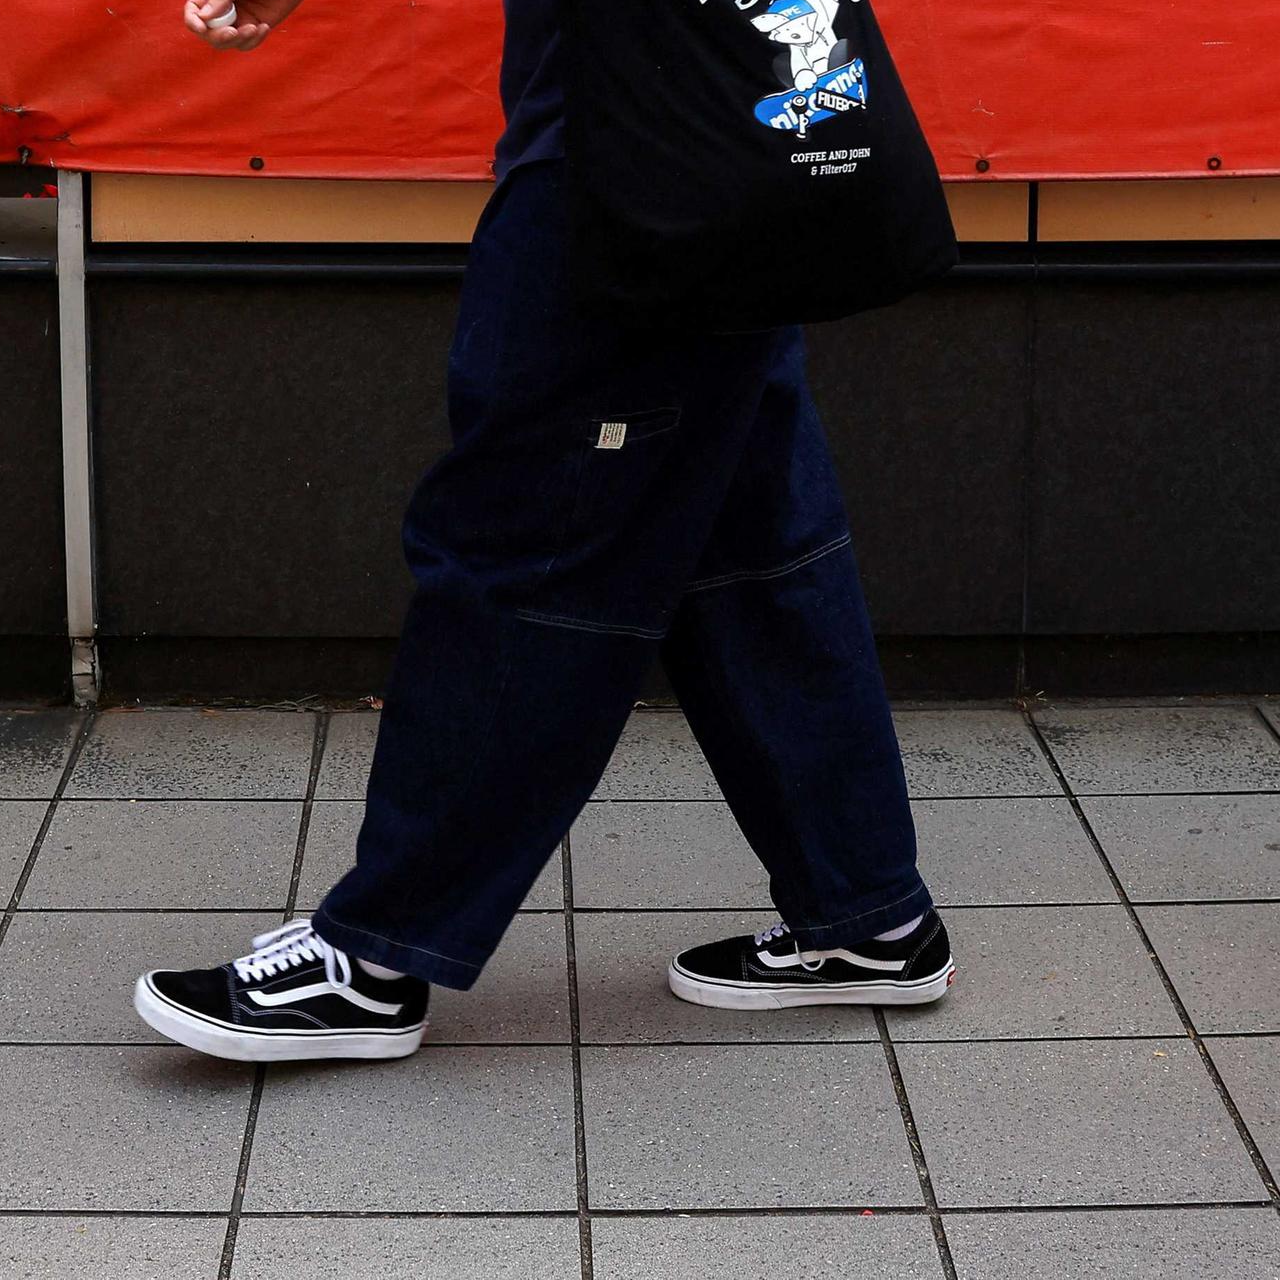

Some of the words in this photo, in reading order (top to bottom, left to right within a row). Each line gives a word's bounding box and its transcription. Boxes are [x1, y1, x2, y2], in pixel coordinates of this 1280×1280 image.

[790, 151, 827, 163] COFFEE
[828, 150, 848, 160] AND
[848, 147, 871, 160] JOHN
[810, 166, 818, 176] &
[819, 162, 858, 175] Filter017
